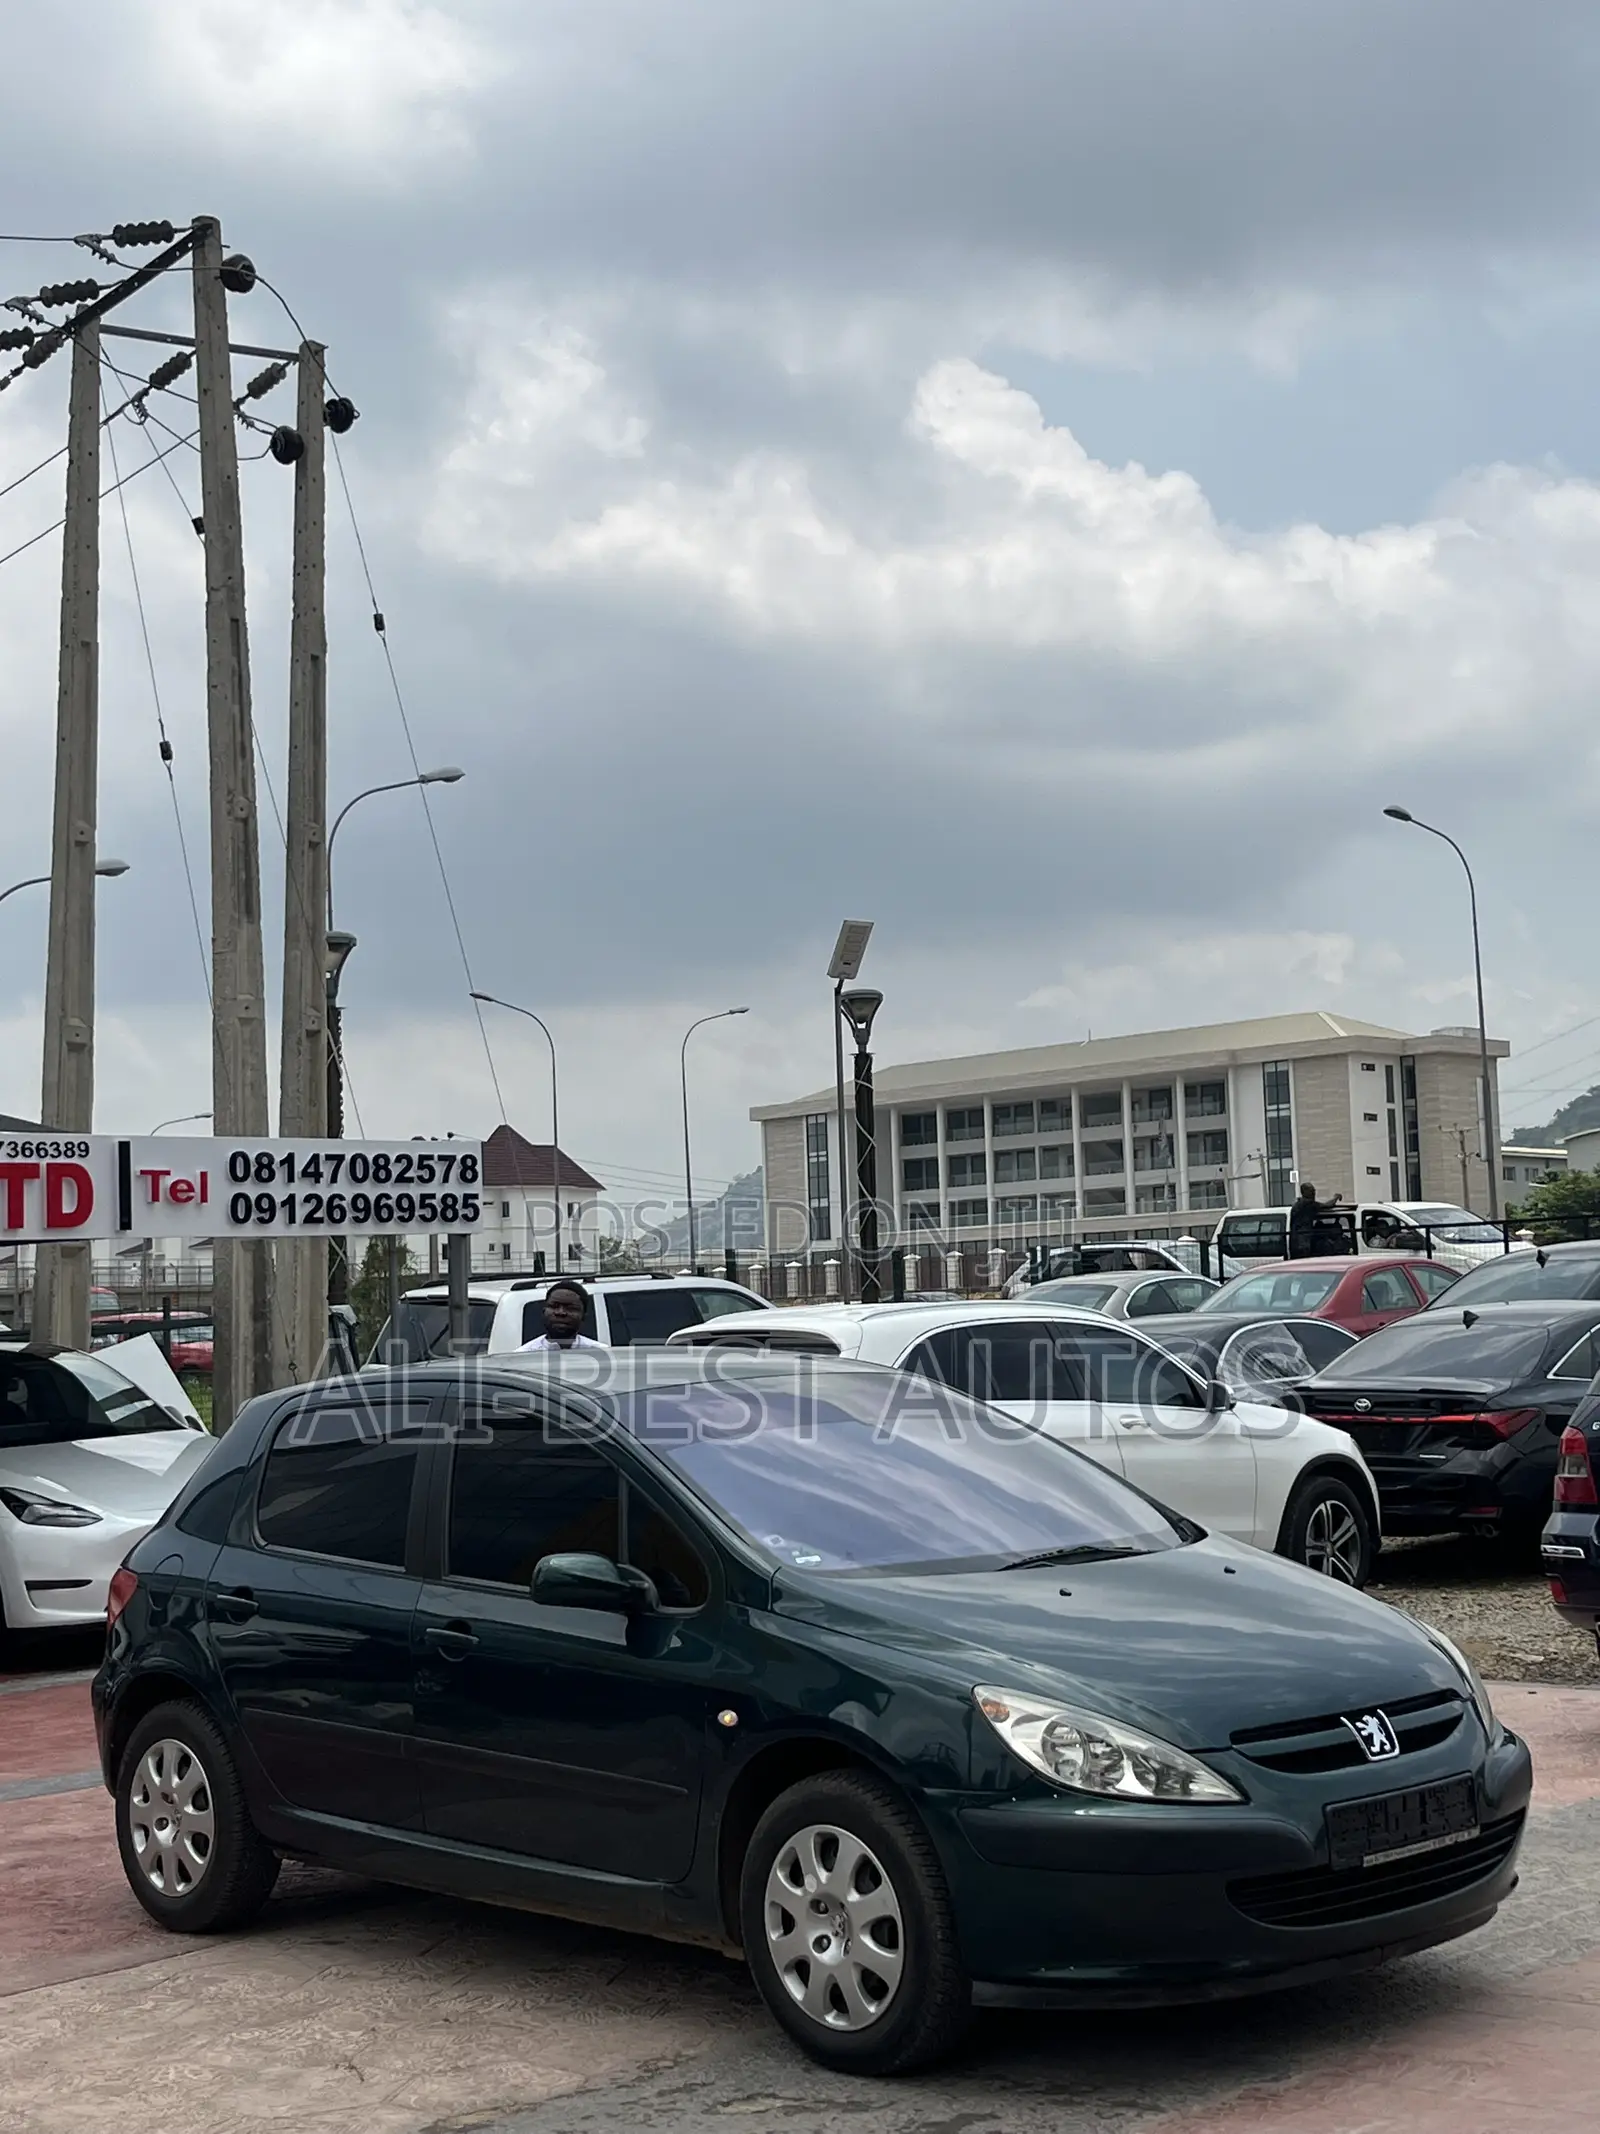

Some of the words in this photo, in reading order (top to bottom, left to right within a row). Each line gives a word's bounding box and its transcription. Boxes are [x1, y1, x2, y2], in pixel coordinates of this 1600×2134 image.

[229, 1150, 479, 1184] 08147082578
[139, 1169, 209, 1204] Tel
[230, 1192, 480, 1225] 09126969585
